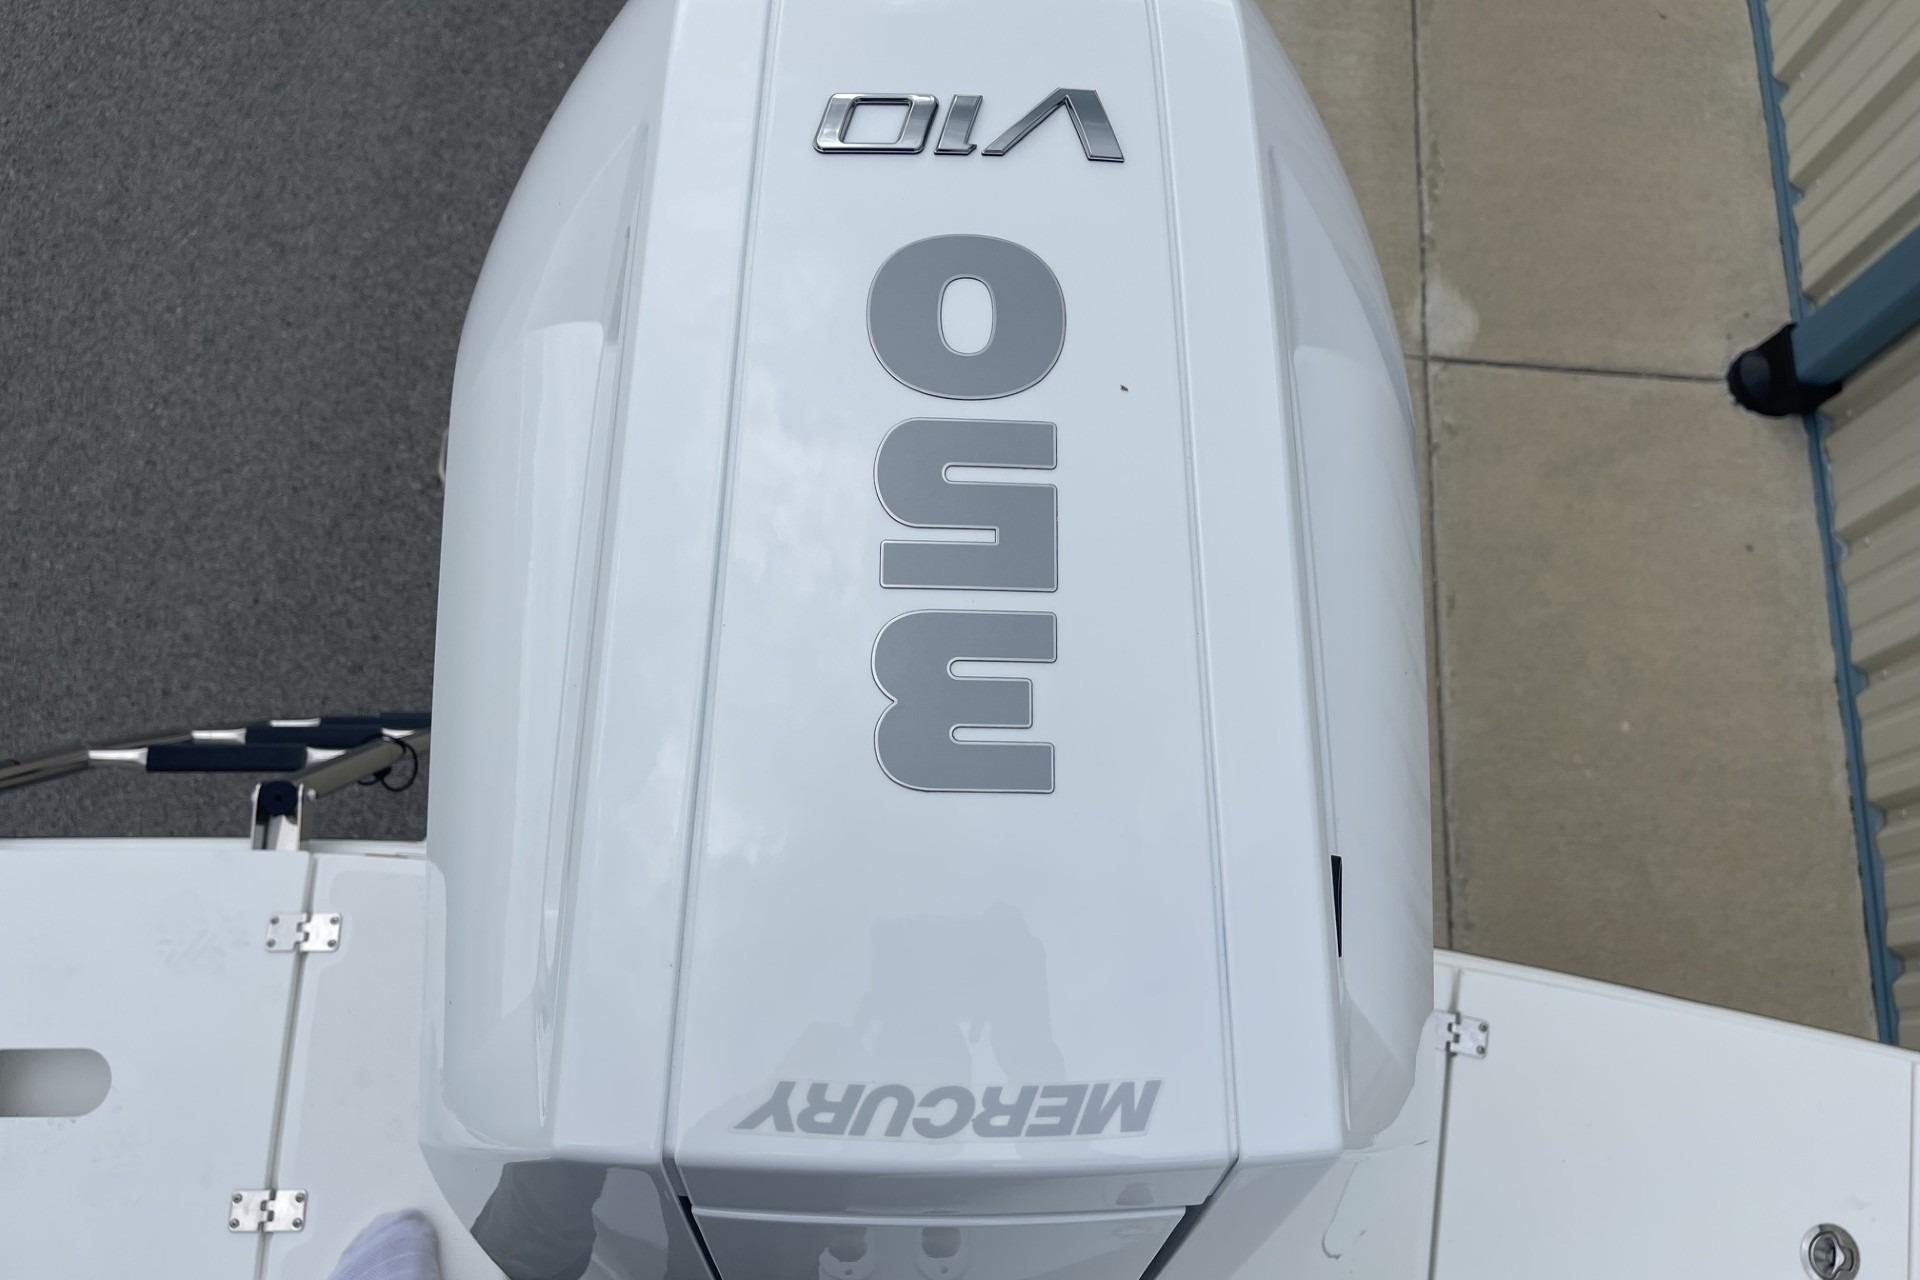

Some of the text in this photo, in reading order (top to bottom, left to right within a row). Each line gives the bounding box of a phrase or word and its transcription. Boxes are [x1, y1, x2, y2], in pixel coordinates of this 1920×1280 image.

[813, 87, 1125, 163] V10
[866, 233, 1067, 794] 350
[733, 1079, 1162, 1139] MERCURY
